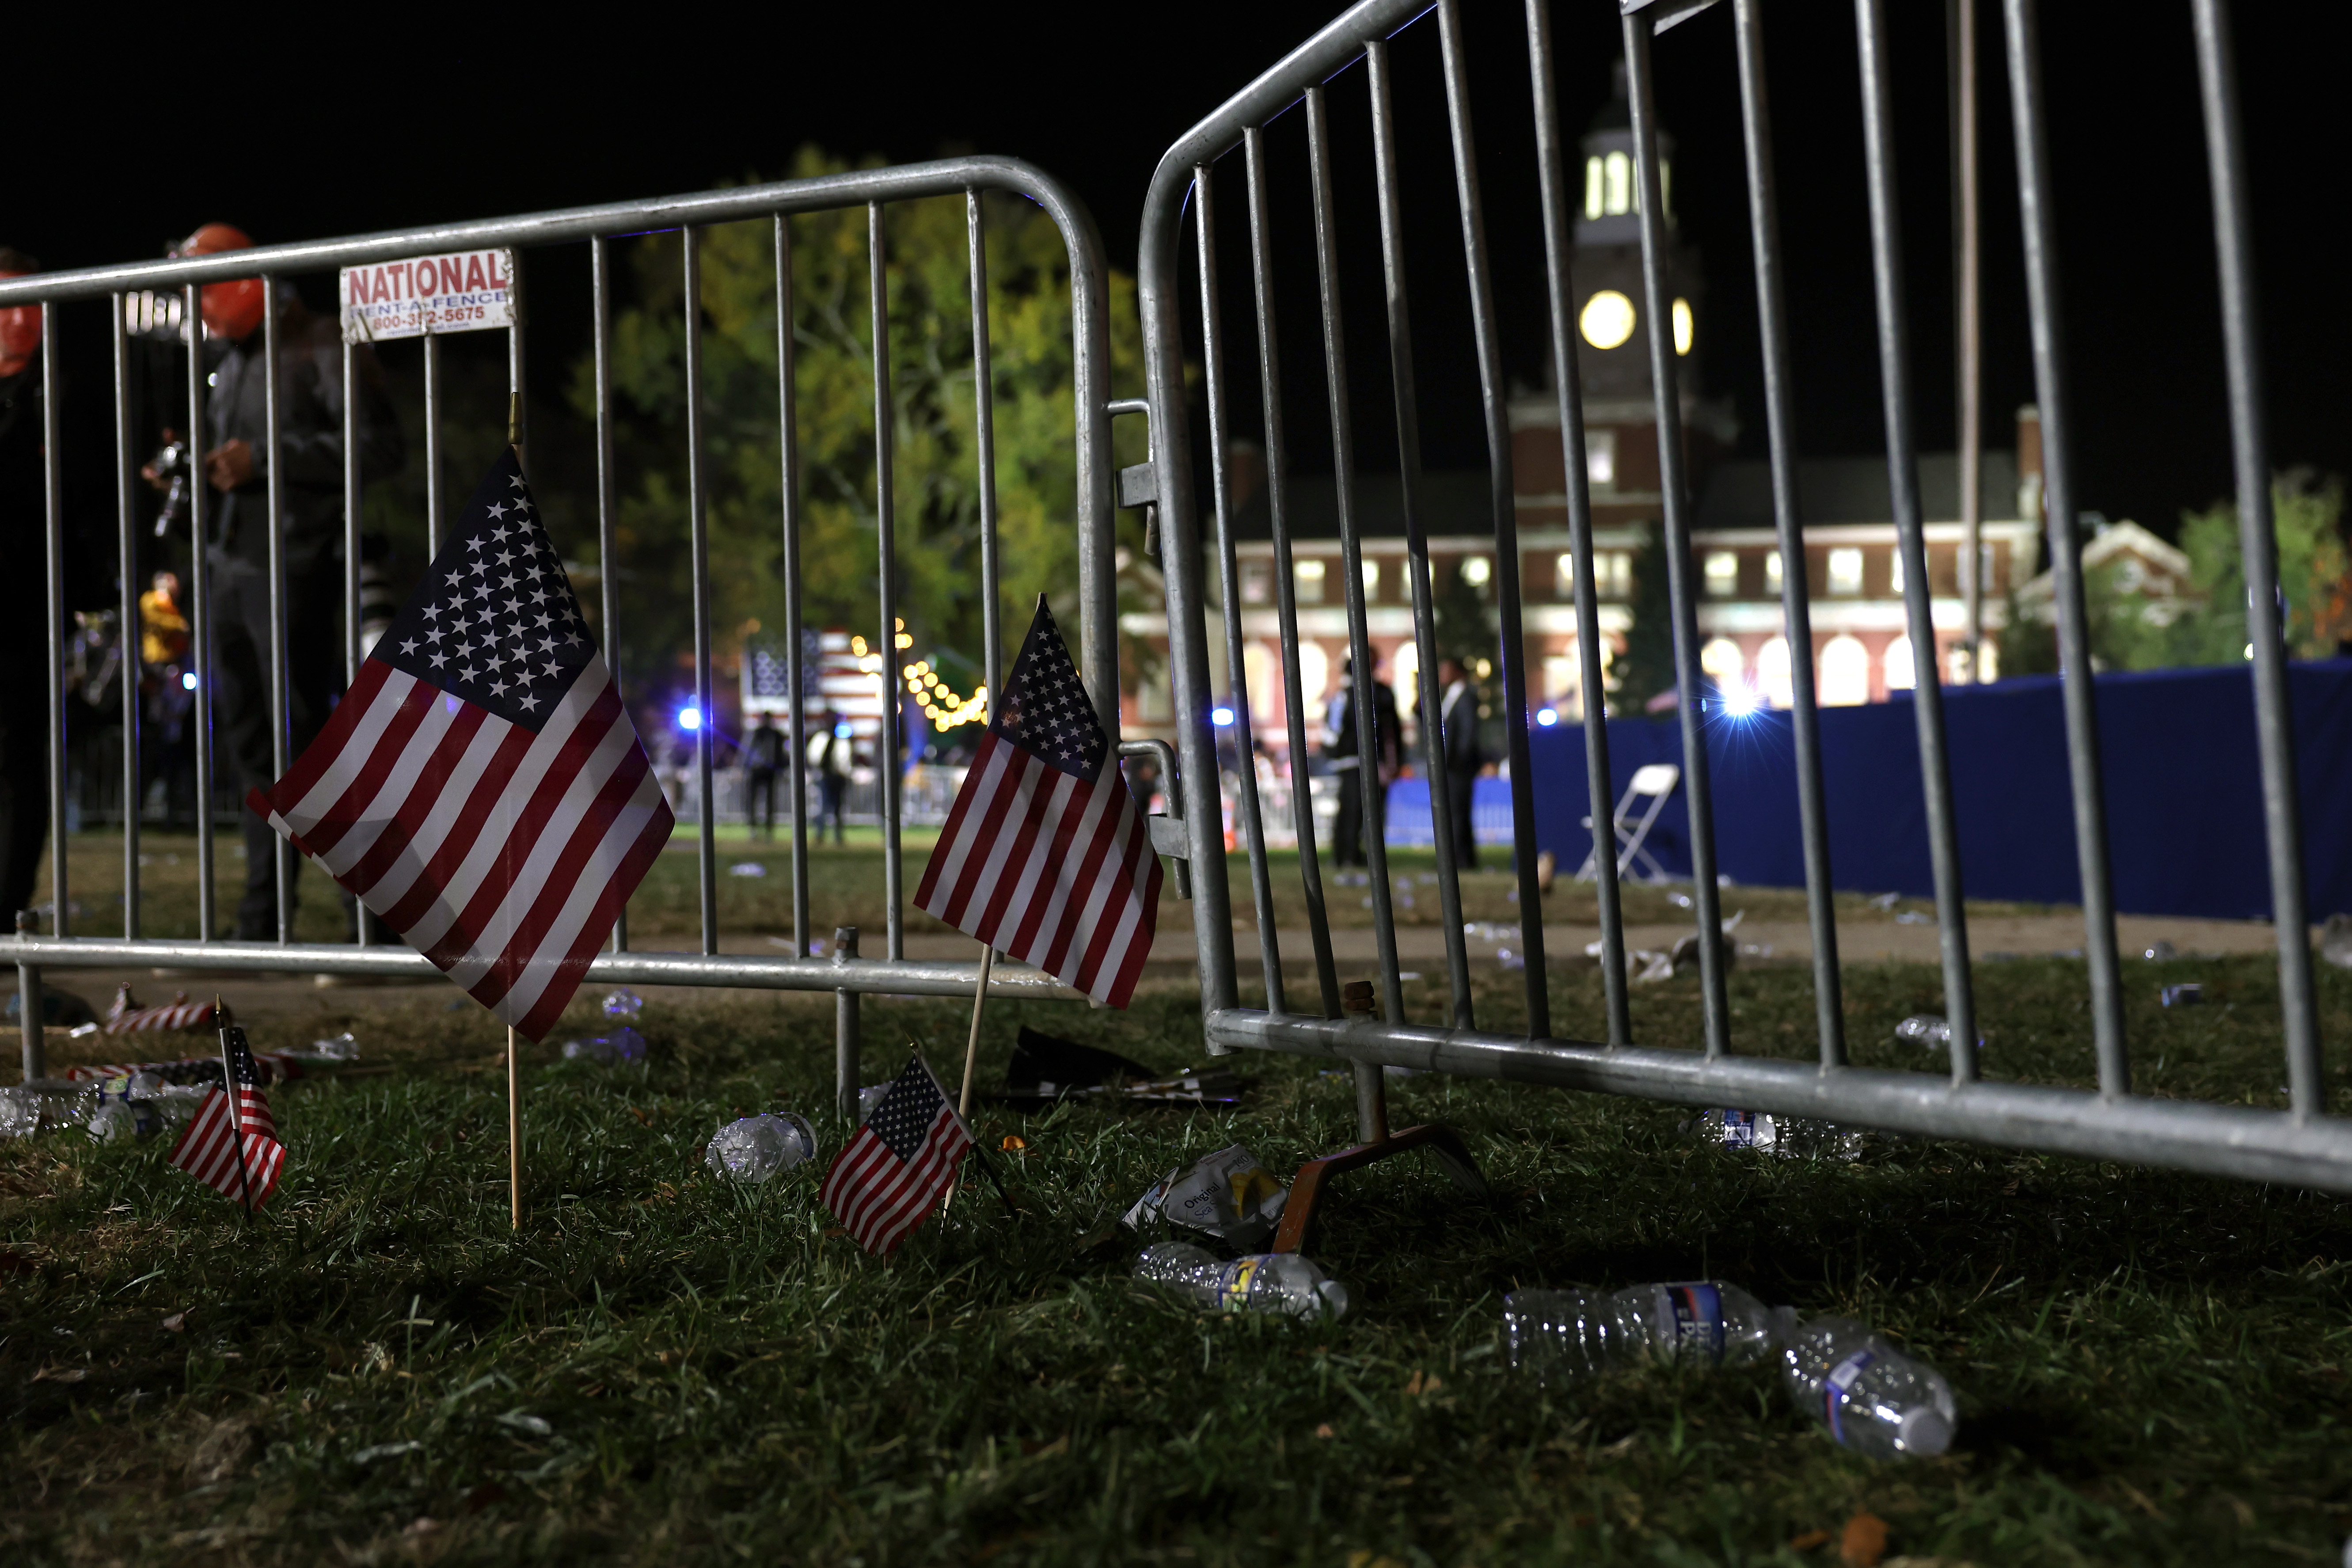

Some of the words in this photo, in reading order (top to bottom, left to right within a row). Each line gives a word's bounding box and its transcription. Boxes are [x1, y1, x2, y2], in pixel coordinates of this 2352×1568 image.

[350, 253, 507, 305] NATIONAL
[1184, 1182, 1221, 1208] Original
[1194, 1206, 1213, 1219] Sea
